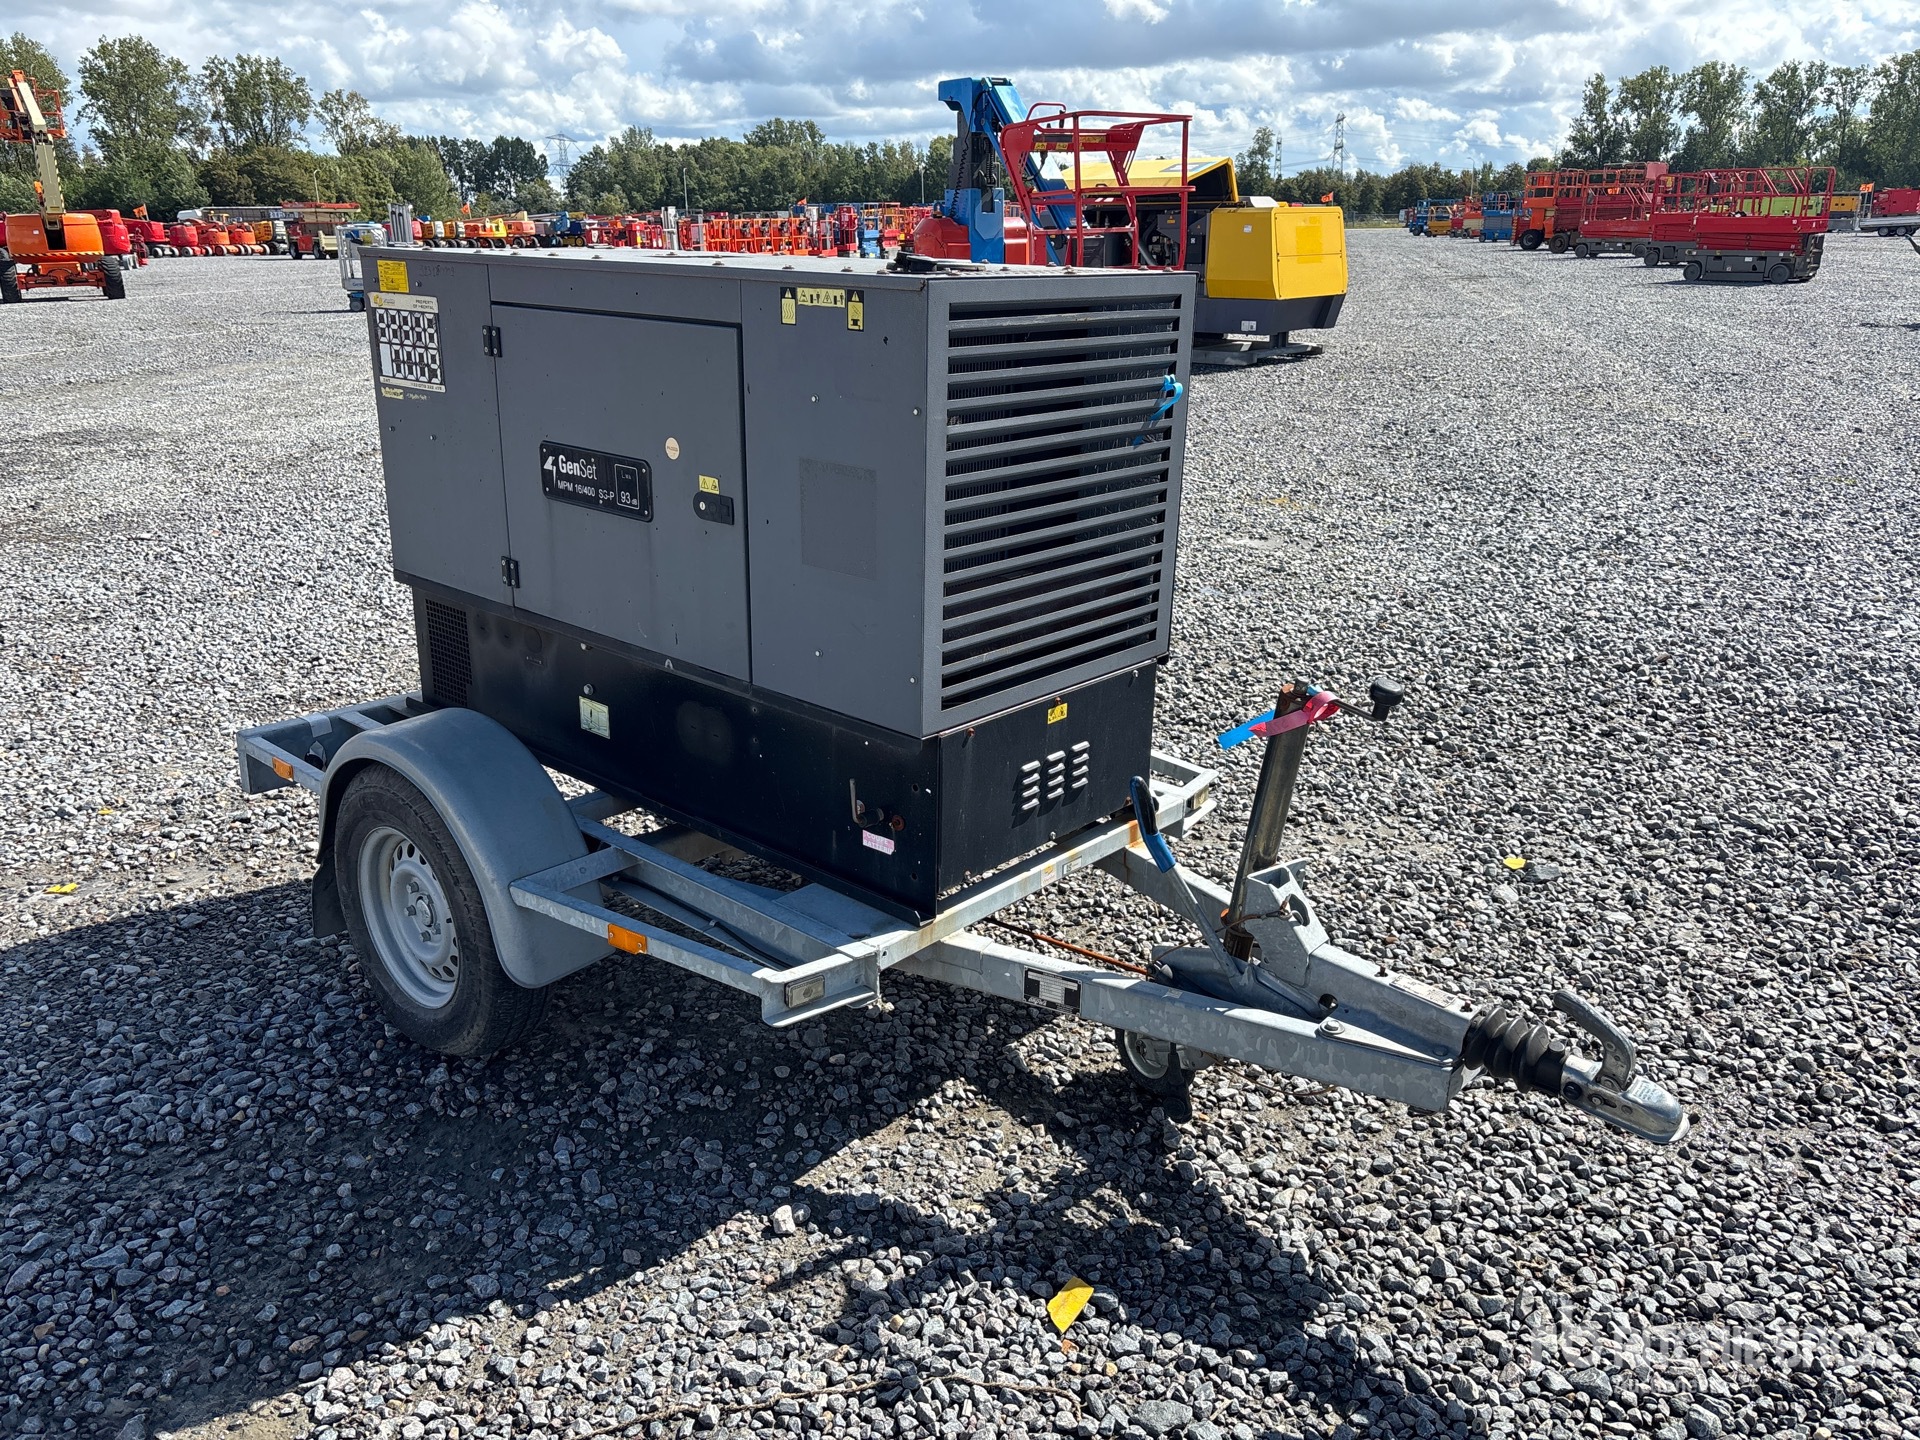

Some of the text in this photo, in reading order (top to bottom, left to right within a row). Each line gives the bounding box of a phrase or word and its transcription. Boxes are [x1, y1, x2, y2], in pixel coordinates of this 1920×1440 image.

[558, 454, 598, 481] GenSet
[557, 479, 574, 492] MPM
[575, 484, 595, 497] 16/400
[620, 490, 631, 504] 93
